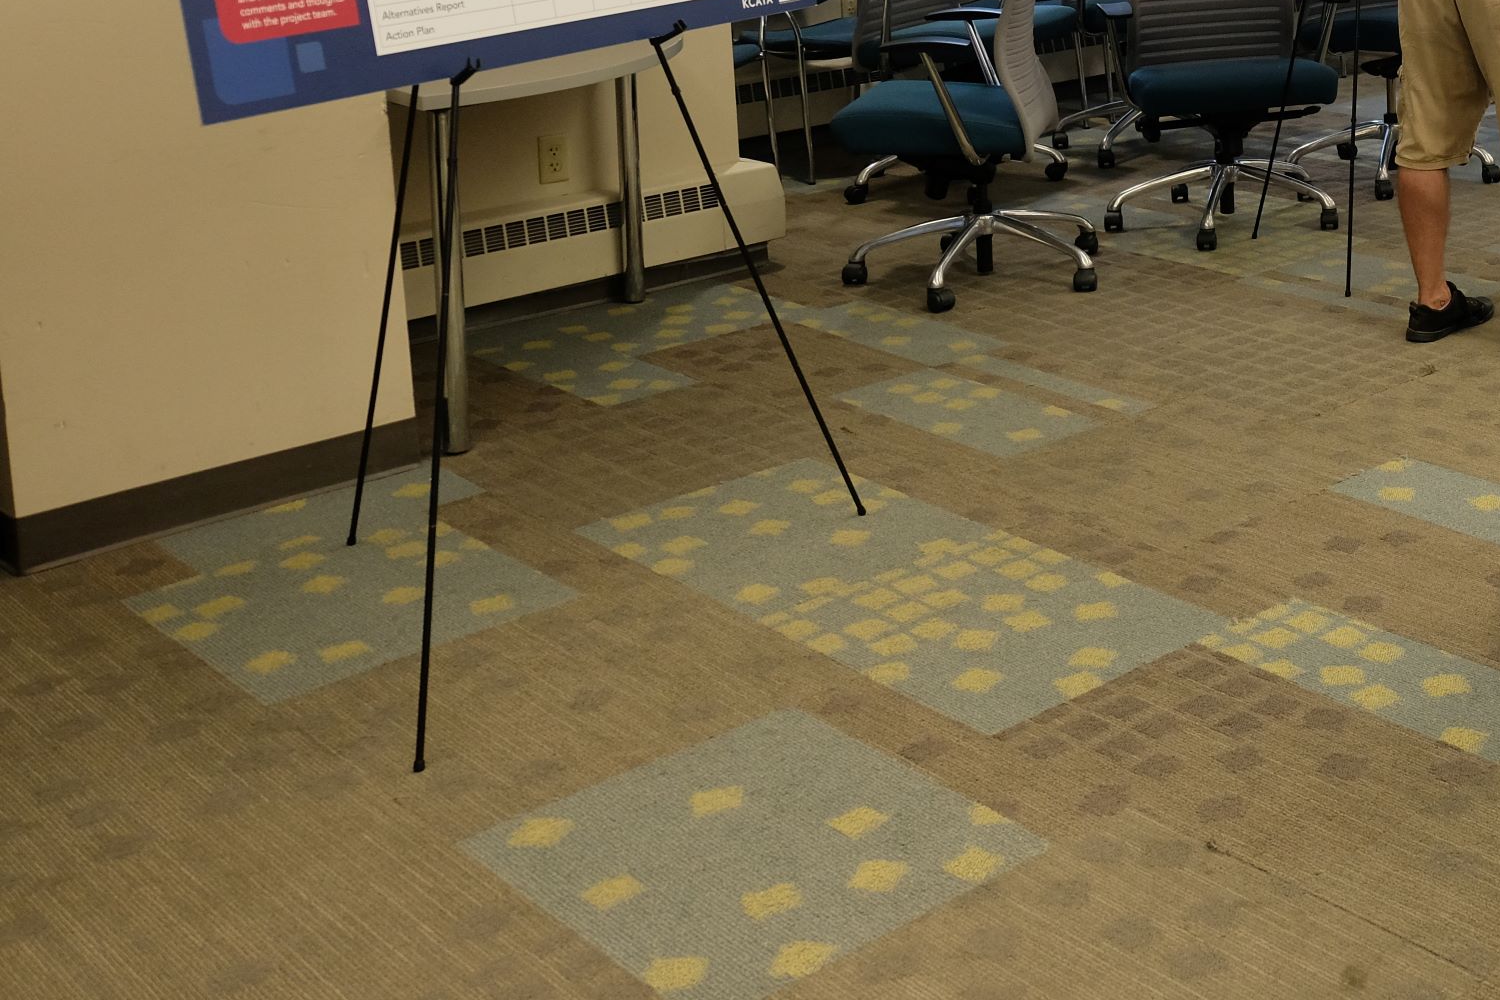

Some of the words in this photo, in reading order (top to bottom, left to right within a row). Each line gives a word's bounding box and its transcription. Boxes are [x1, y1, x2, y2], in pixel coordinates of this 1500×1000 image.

[240, 2, 286, 16] comments
[288, 0, 305, 10] and
[382, 6, 433, 19] Alternatives
[436, 0, 465, 13] Report
[242, 18, 262, 29] with
[264, 16, 279, 26] the
[280, 10, 311, 27] project
[313, 9, 337, 18] team.
[386, 29, 414, 40] Action
[416, 25, 435, 34] Plan
